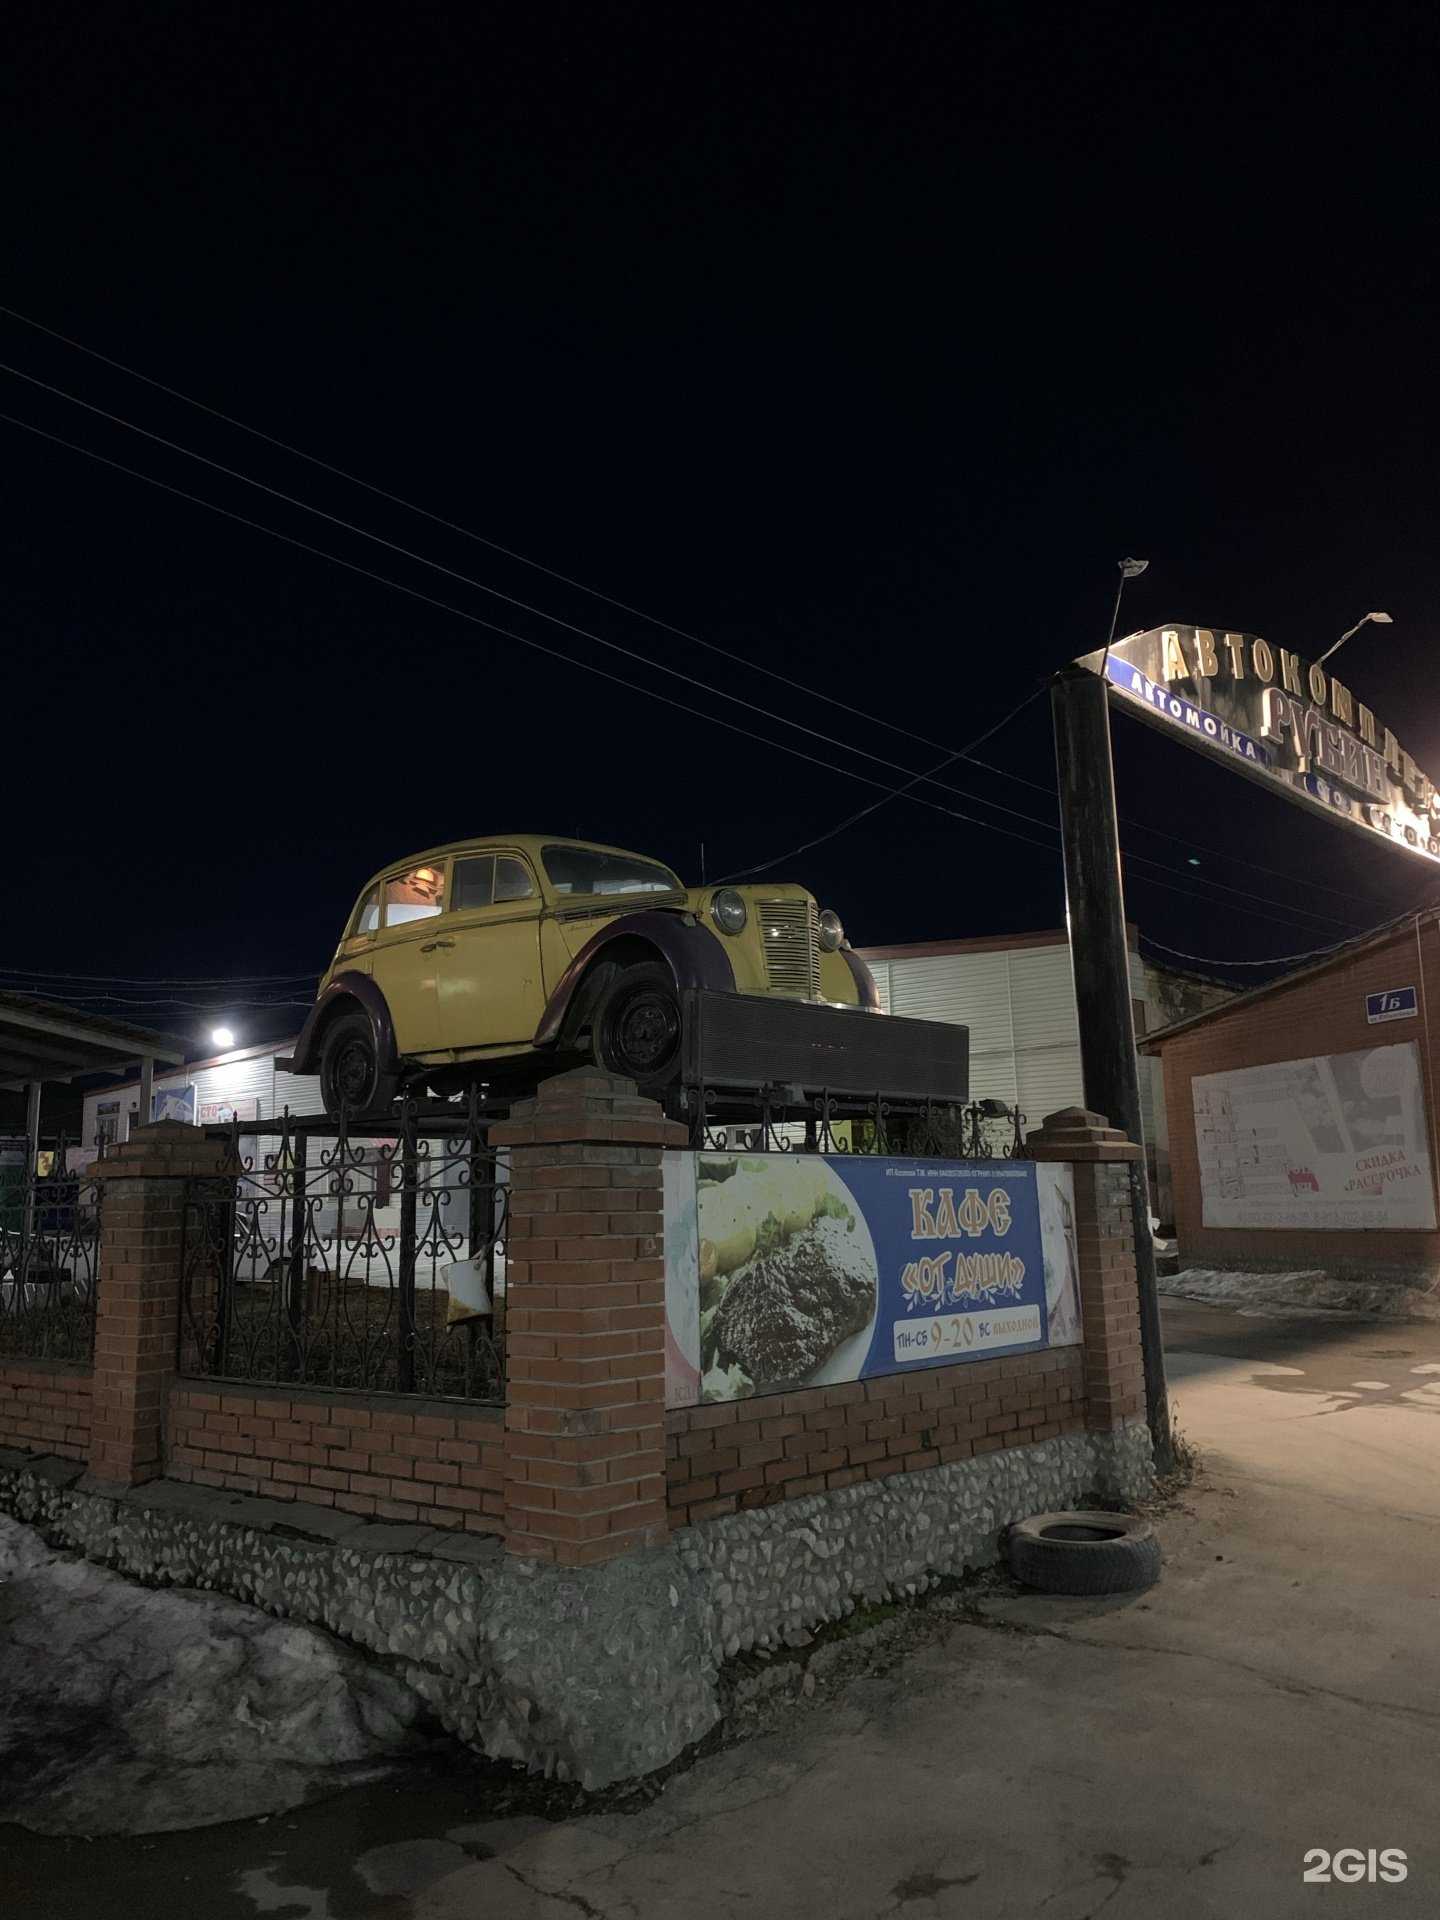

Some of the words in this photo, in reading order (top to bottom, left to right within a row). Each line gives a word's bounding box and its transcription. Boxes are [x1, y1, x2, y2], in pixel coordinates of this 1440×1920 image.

[1131, 672, 1257, 759] АВТОМОЙКА
[1161, 630, 1440, 812] АВТОКОМПЛЕ
[1260, 686, 1391, 804] РУБИН
[1348, 1164, 1422, 1191] РАССРОЧКА
[1355, 1150, 1407, 1172] СКИДКА
[909, 1188, 1012, 1239] КАФЕ
[896, 1330, 928, 1348] ПН-СБ
[931, 1317, 974, 1351] 9-20
[978, 1322, 991, 1338] ВС
